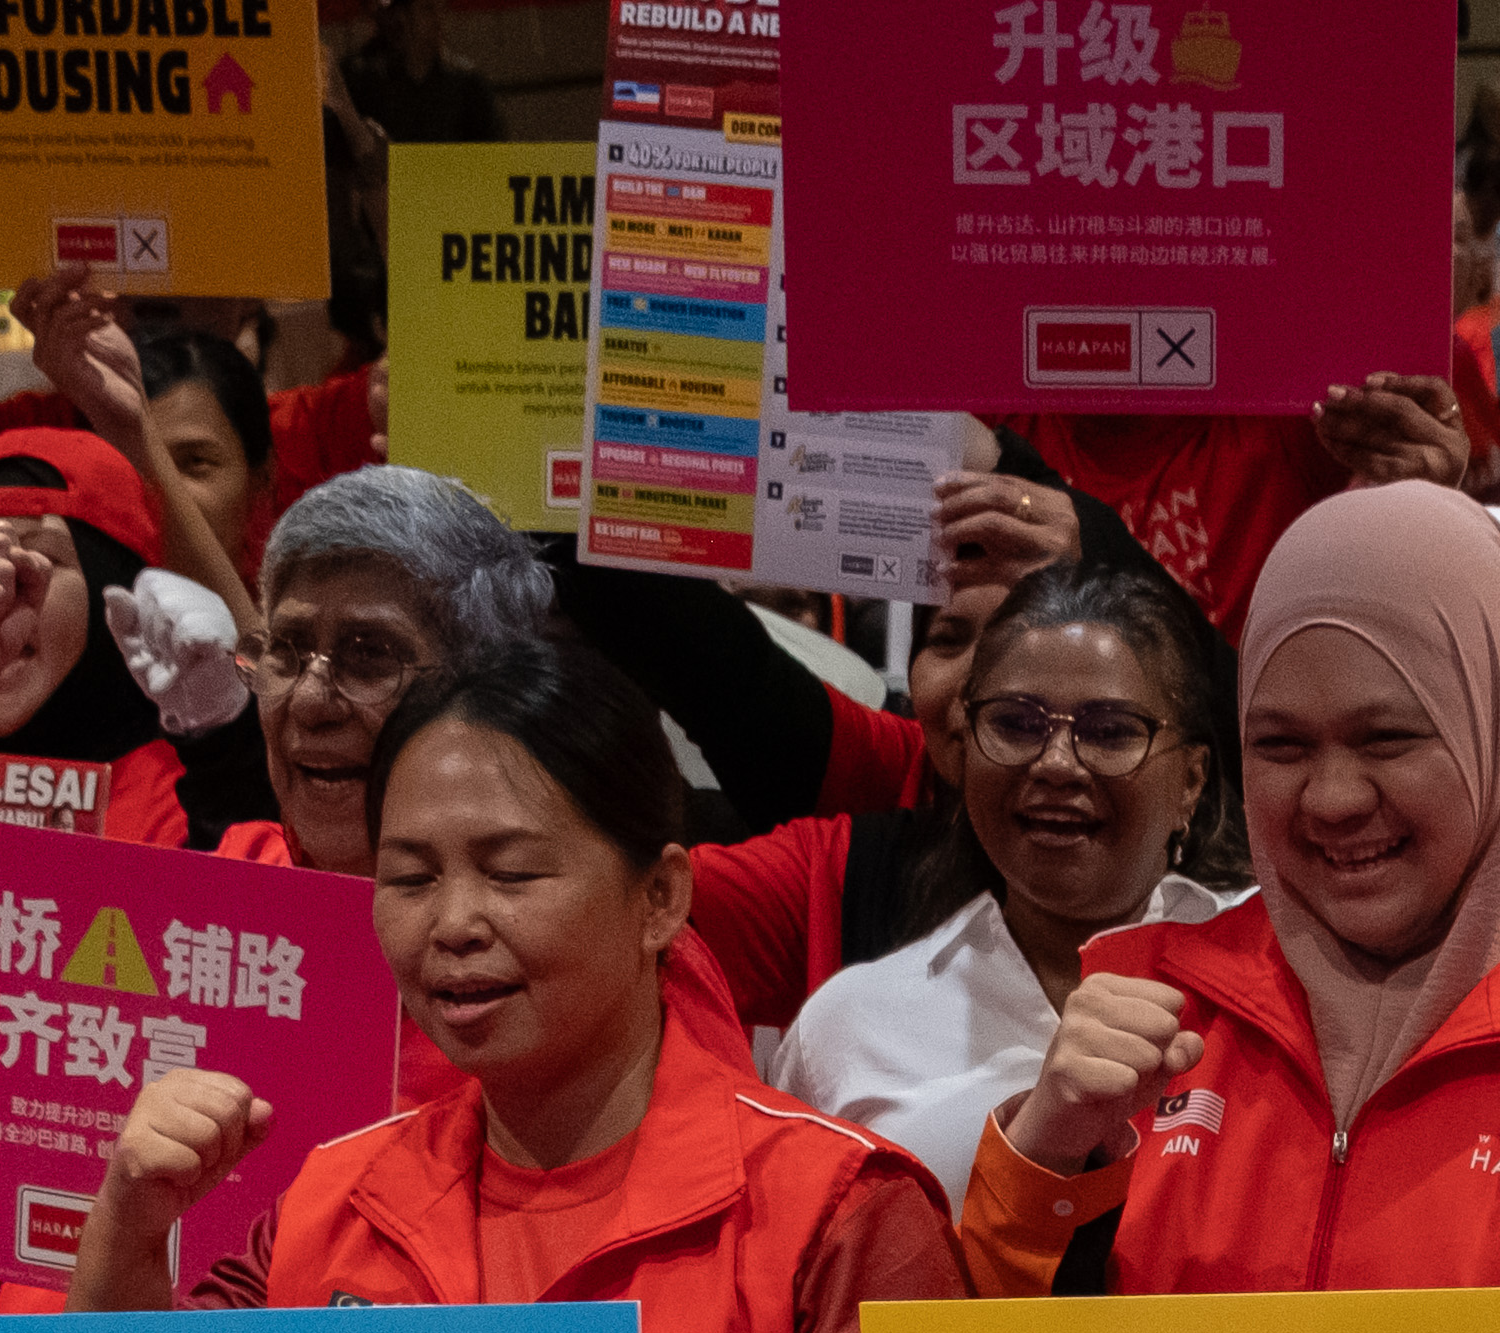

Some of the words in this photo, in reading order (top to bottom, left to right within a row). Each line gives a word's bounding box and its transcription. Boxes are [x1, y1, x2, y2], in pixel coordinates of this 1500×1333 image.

[621, 3, 723, 32] REBUILD
[727, 13, 745, 35] A
[992, 0, 1160, 86] 升级
[951, 102, 1285, 189] 区域港口
[1042, 340, 1126, 354] HARAPAN
[162, 919, 307, 1020] 铺路
[1161, 1136, 1199, 1156] AIN
